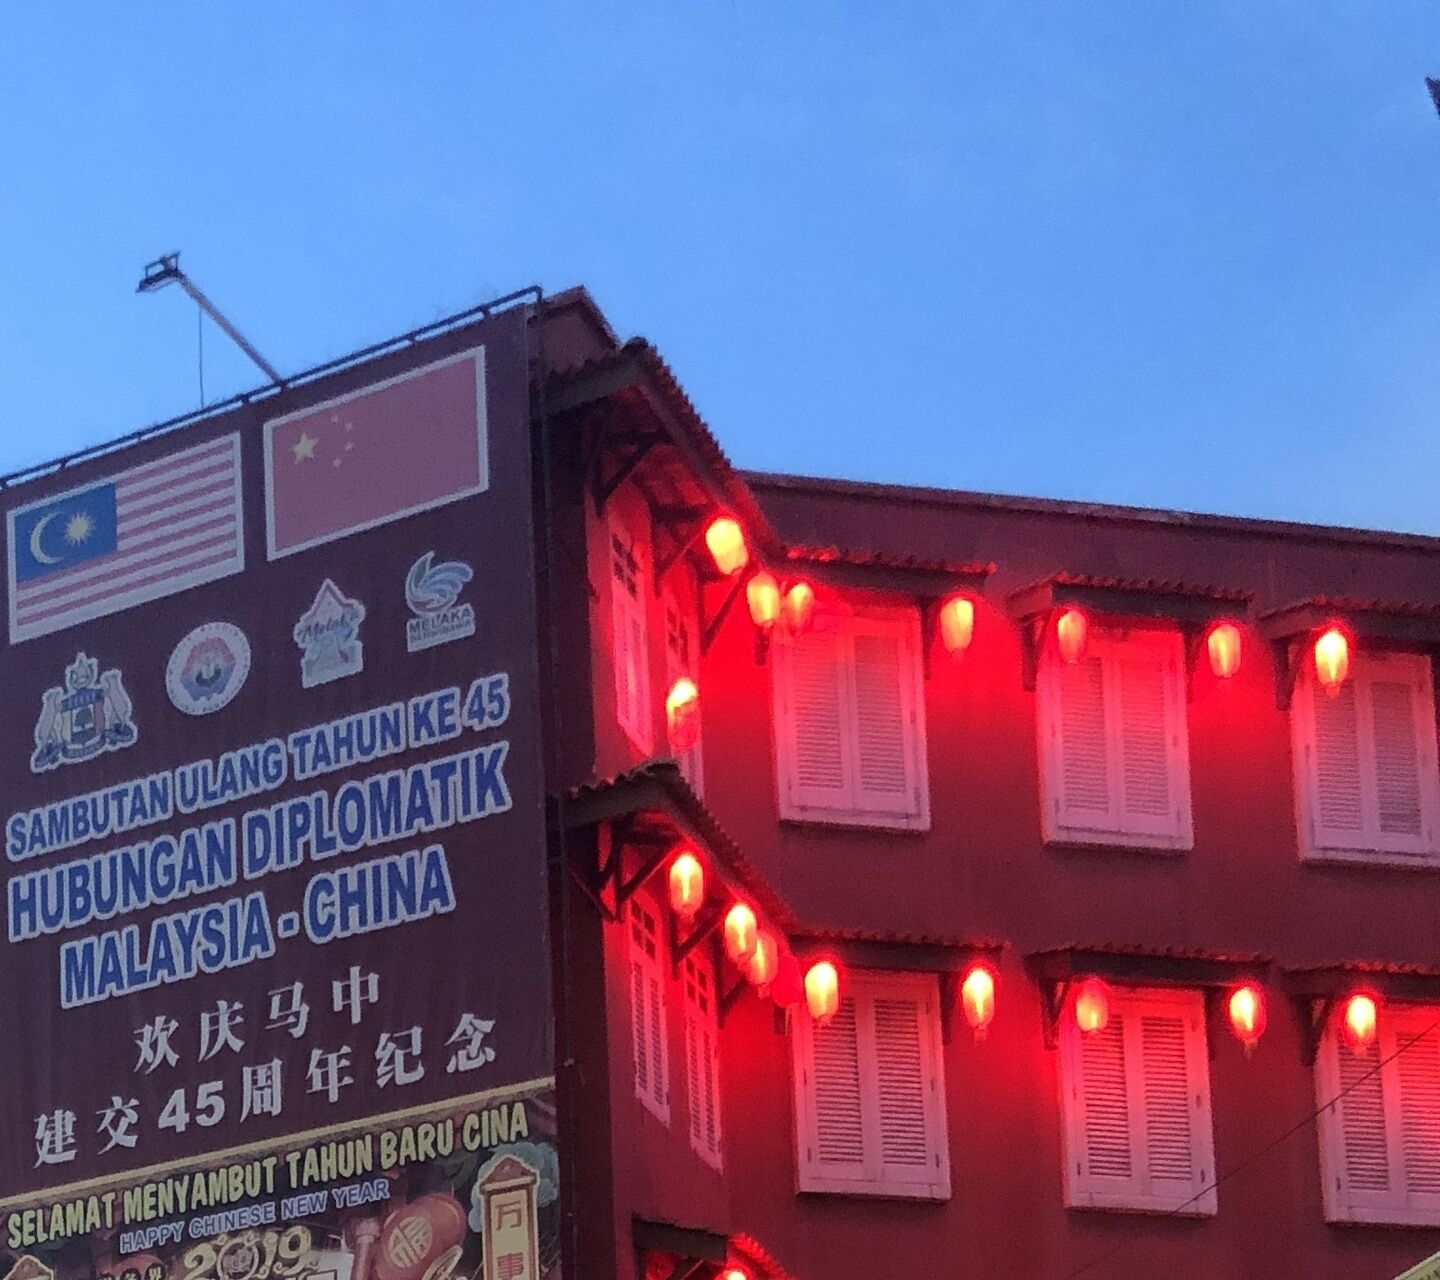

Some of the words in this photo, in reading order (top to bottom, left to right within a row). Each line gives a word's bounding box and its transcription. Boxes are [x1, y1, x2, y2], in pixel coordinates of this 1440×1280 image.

[409, 605, 472, 633] MELAKA
[7, 772, 173, 860] SAMBUTAN
[176, 739, 288, 813] ULANG
[290, 702, 406, 780] TAHUN
[409, 687, 461, 749] KE
[463, 673, 510, 730] 45
[8, 817, 236, 942] HUBUNGAN
[242, 742, 511, 879] DIPLOMATIK
[61, 892, 275, 1008] MALAYSIA
[303, 844, 456, 944] CHINA
[33, 1012, 497, 1170] 建交45周年纪念
[133, 965, 380, 1076] 欢庆马中
[7, 1195, 117, 1250] SELAMAT
[122, 1157, 277, 1224] MENYAMBUT
[285, 1134, 373, 1185] TAHUN
[379, 1117, 453, 1166] BARU
[462, 1101, 528, 1149] CINA
[120, 1222, 184, 1254] HAPPY
[189, 1205, 276, 1239] CHINESE
[281, 1191, 328, 1220] NEW
[333, 1179, 390, 1208] YEAR
